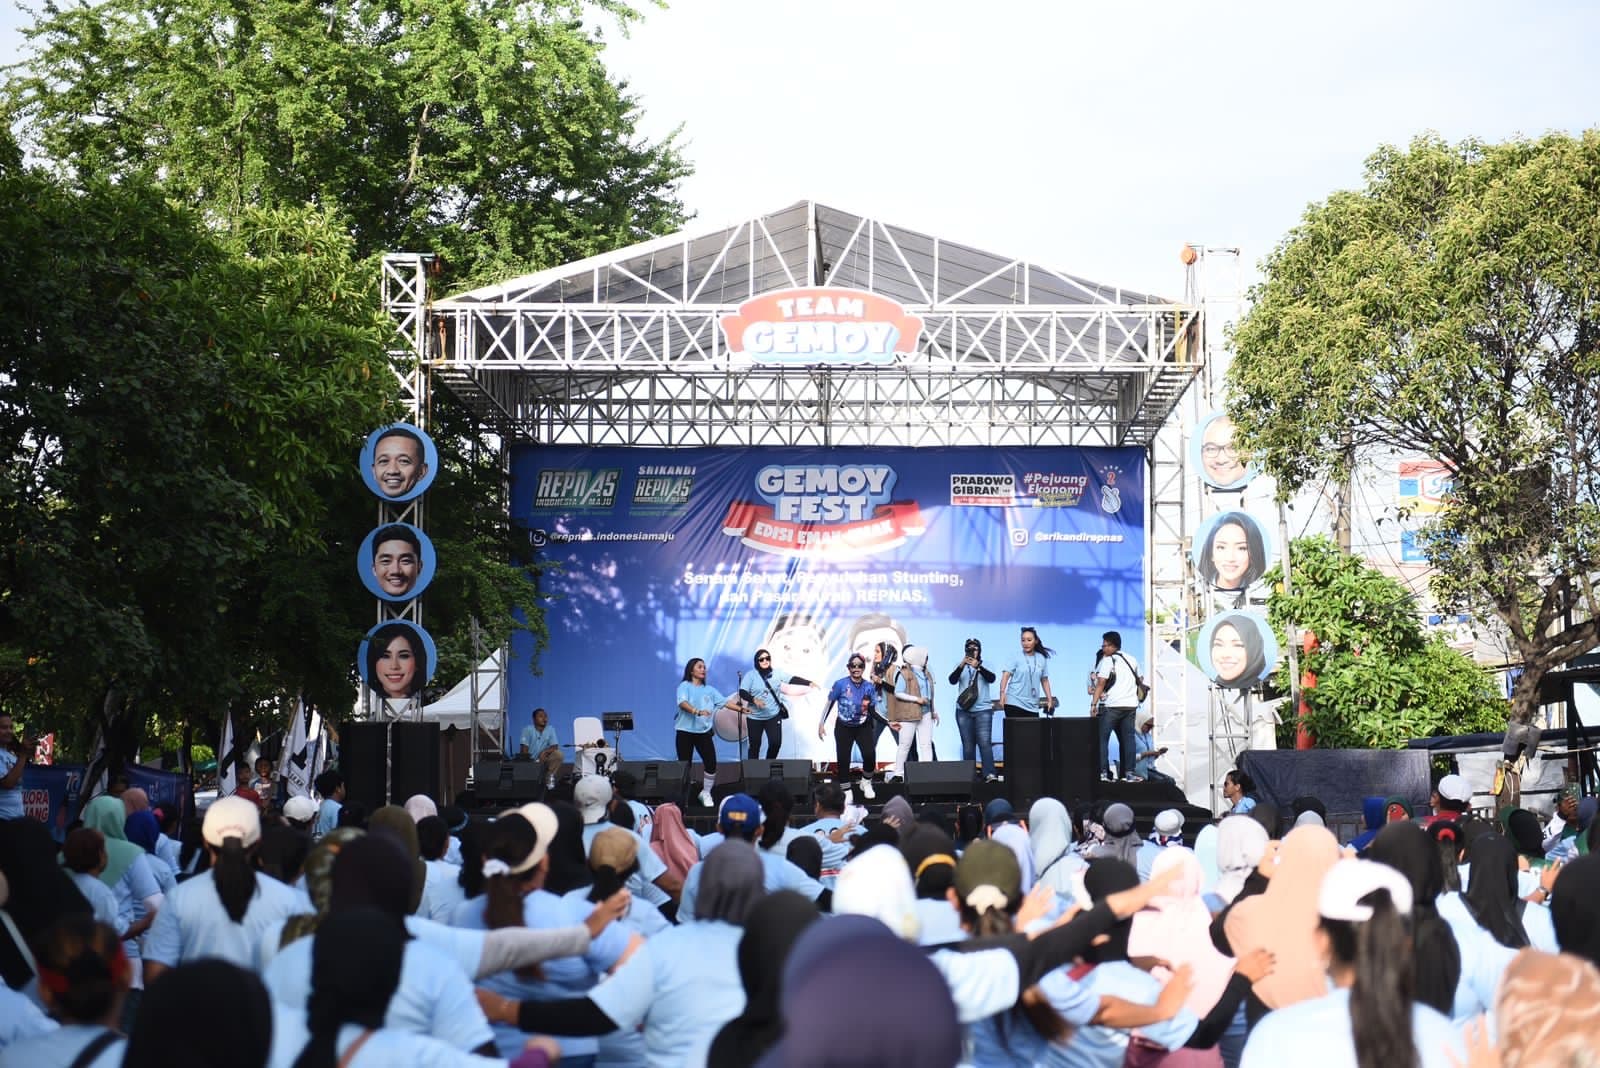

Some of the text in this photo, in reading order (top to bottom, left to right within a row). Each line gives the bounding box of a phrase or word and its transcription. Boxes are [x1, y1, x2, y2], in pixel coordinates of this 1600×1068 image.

[777, 296, 865, 318] TEAM
[749, 323, 893, 354] GEMOY
[638, 466, 696, 476] SRIKANDI
[537, 471, 618, 500] REPNAS
[758, 468, 889, 493] GEMOY
[953, 476, 1013, 486] PRABOWO
[1023, 473, 1088, 486] #Pejuang
[635, 478, 691, 499] REPNAS
[953, 487, 999, 495] GIBRAN
[1027, 485, 1083, 495] Ekonomi
[779, 496, 867, 521] FEST
[550, 531, 675, 543] @repns.indonesiamaju
[754, 521, 793, 542] EDISI
[1035, 532, 1124, 543] @srikandirepnas
[684, 571, 735, 585] Senam
[892, 570, 963, 587] Stunting,
[856, 590, 928, 602] REPNAS.
